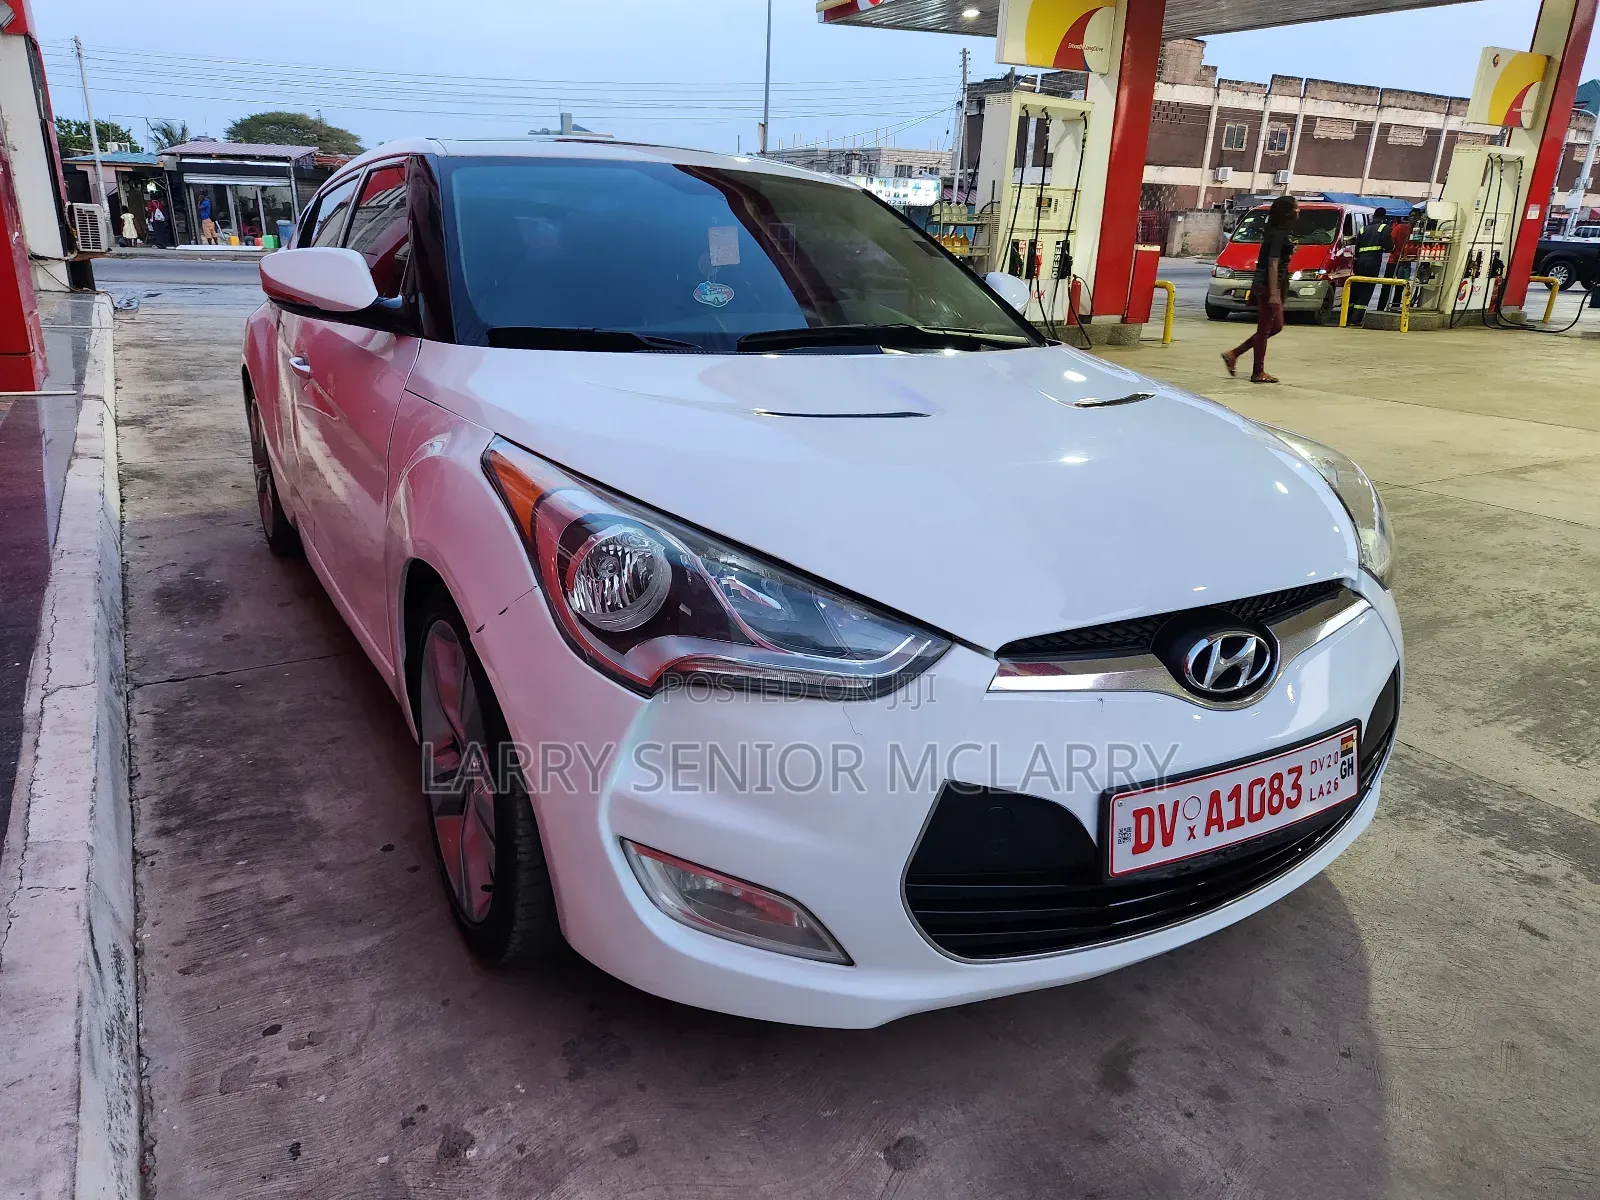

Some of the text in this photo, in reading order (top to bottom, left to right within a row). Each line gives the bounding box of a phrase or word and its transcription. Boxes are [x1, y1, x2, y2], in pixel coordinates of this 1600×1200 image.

[1051, 241, 1063, 278] DIESEL
[1340, 758, 1355, 780] GH
[1131, 765, 1304, 855] DV A1083
